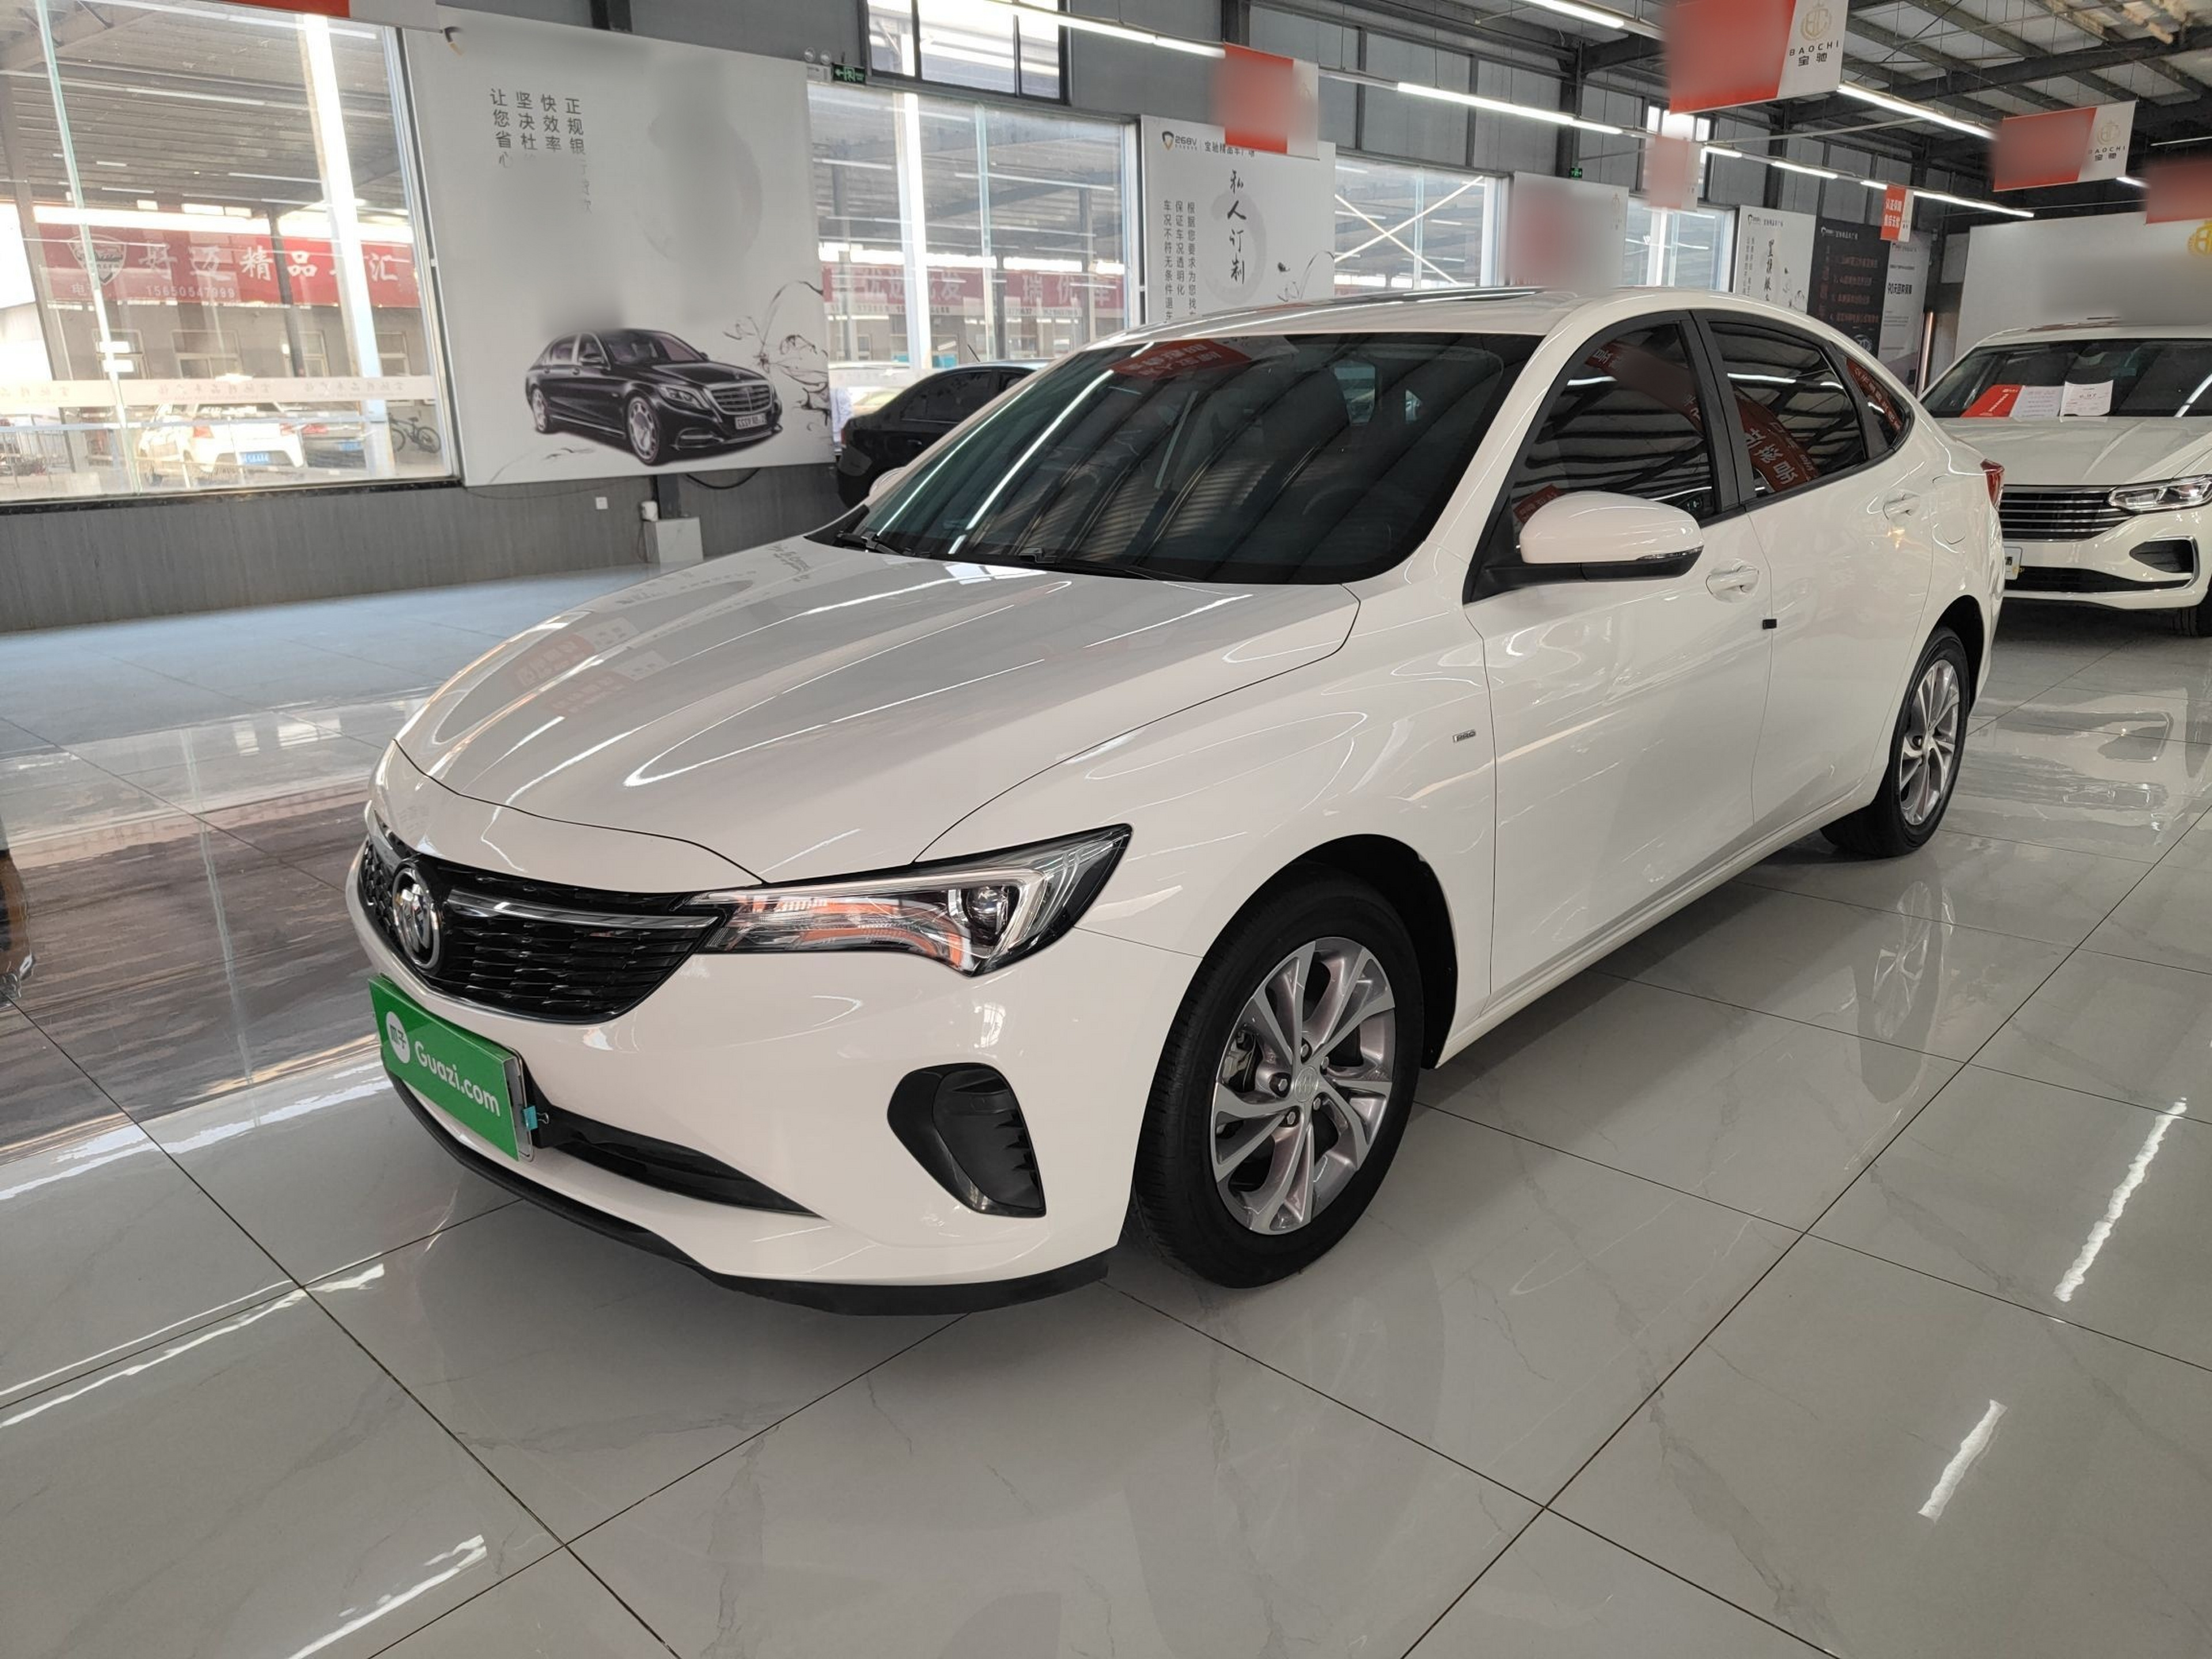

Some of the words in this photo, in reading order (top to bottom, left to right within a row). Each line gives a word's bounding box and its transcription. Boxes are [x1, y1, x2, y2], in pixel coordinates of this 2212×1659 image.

[1789, 40, 1839, 56] BAOCHI
[516, 90, 538, 160] 坚决杜
[541, 93, 562, 152] 快效率
[1175, 135, 1197, 146] 268V
[1228, 170, 1247, 284] 私人订制
[138, 240, 399, 282] 好迈精品汇
[415, 1041, 500, 1116] Guazi.com
